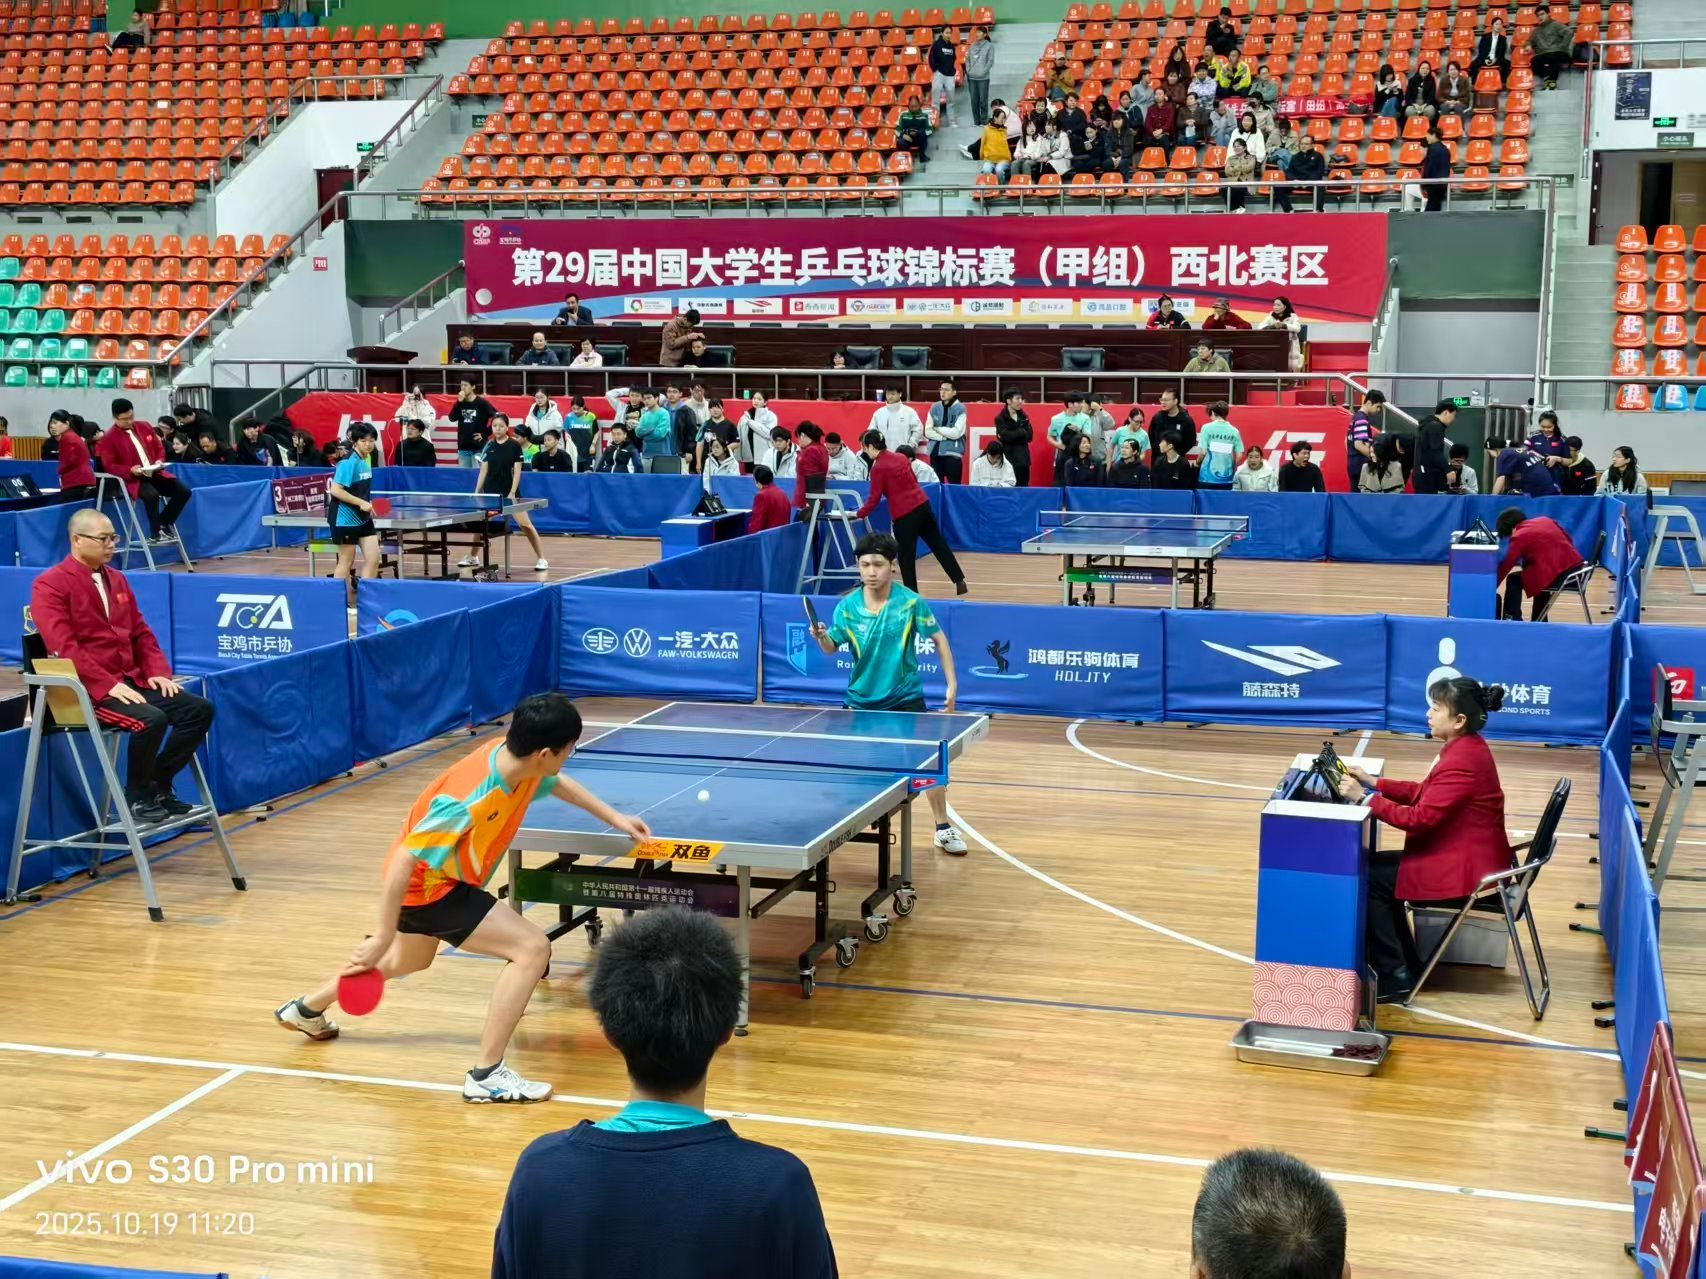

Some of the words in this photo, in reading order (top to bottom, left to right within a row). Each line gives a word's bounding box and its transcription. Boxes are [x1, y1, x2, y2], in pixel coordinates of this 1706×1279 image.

[217, 634, 293, 653] 宝鸡市乒协
[658, 630, 738, 650] 一汽-大众
[657, 649, 739, 660] FAW-VOLKSWAGEN
[1028, 649, 1139, 669] 鸿都乐驹体育
[1242, 681, 1301, 698] 藤森特
[1519, 706, 1551, 716] SPORTS
[670, 843, 711, 861] 双鱼
